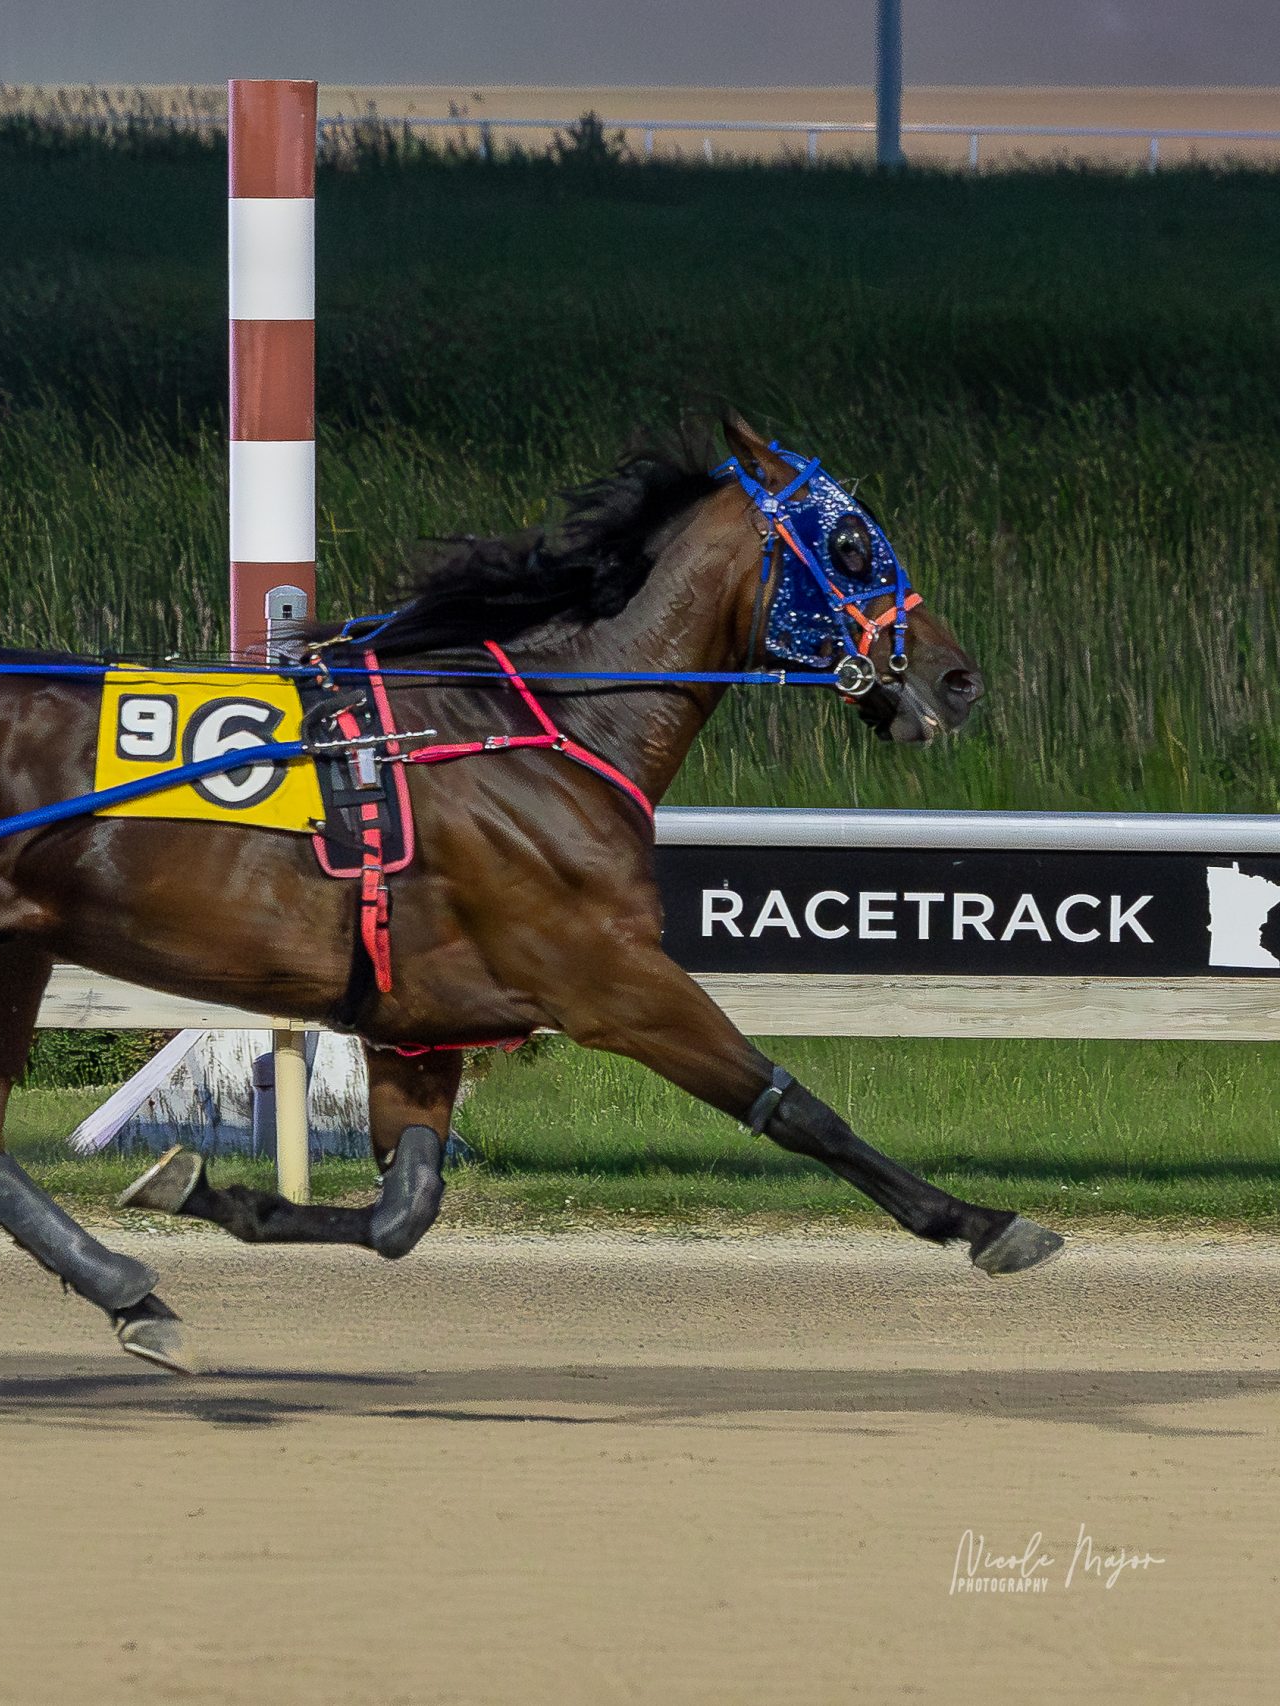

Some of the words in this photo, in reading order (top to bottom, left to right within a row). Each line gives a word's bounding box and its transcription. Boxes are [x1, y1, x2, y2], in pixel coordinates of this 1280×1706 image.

[118, 697, 174, 758] 9
[190, 701, 278, 804] 6
[700, 888, 1155, 944] RACETRACK
